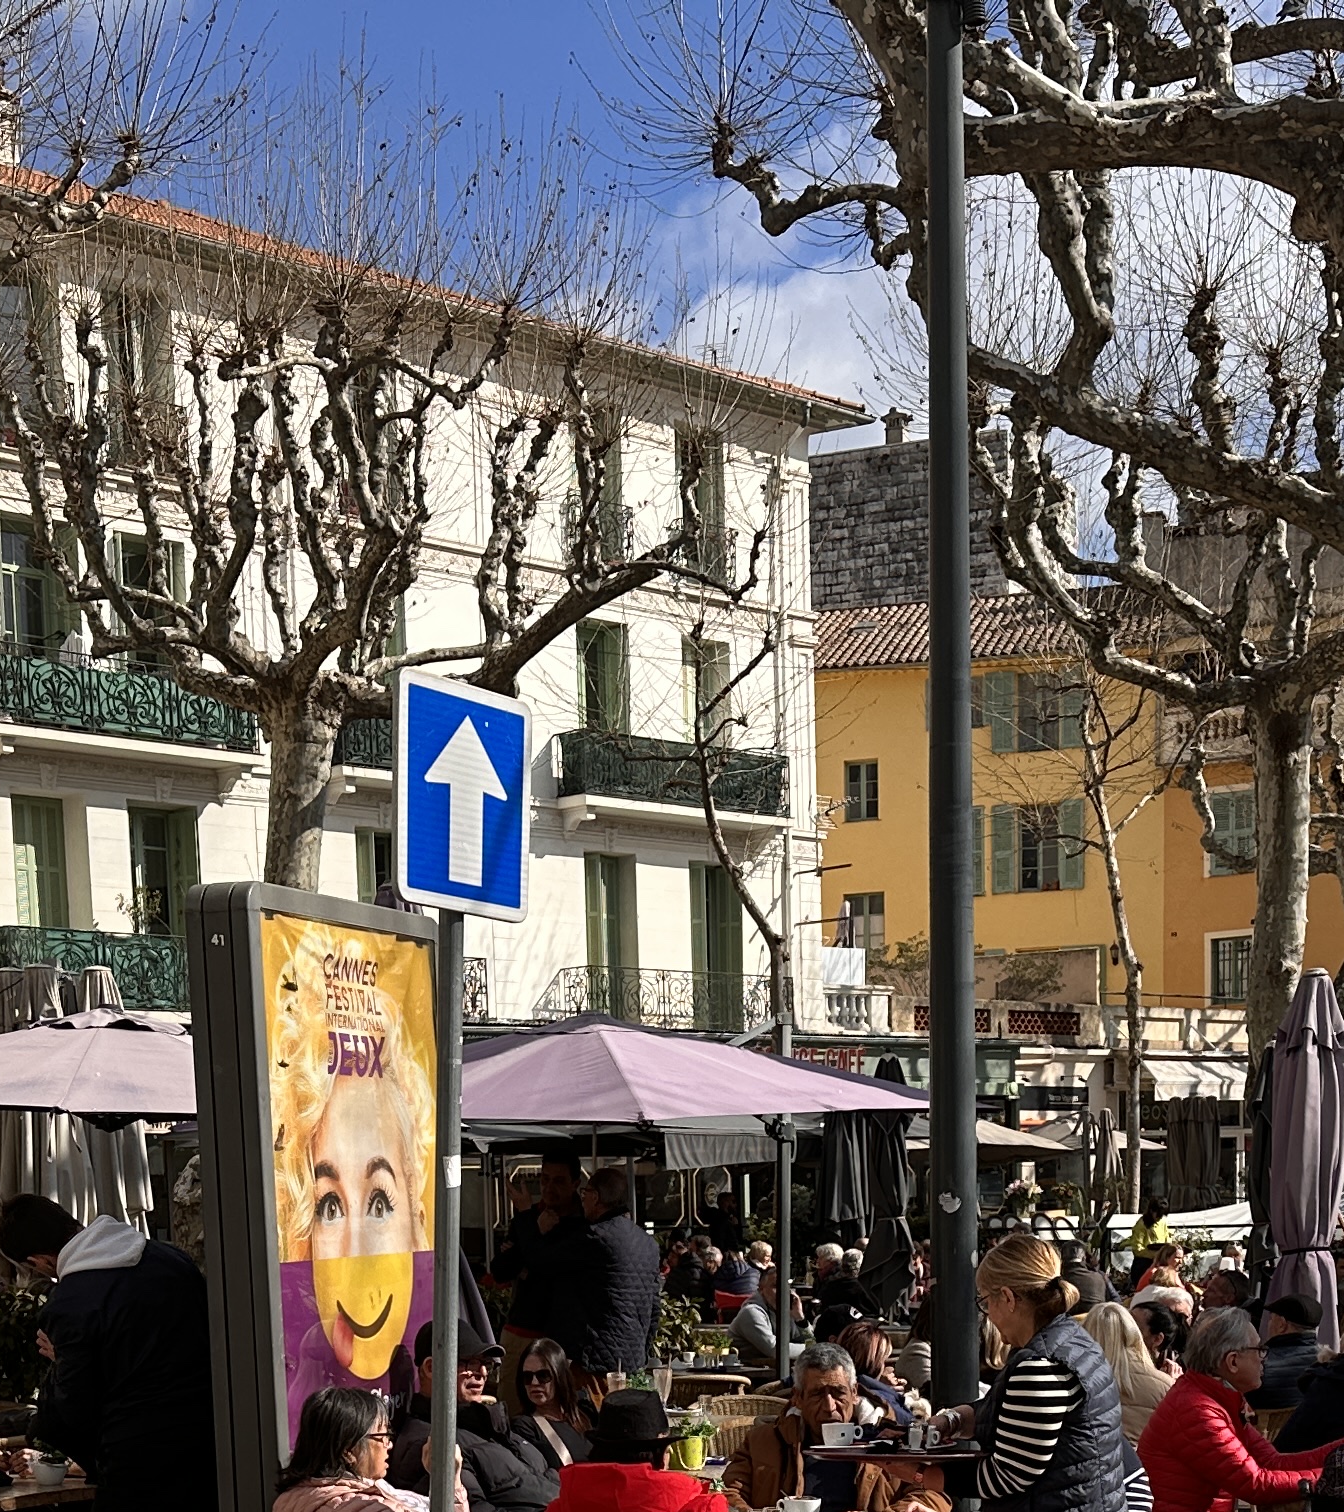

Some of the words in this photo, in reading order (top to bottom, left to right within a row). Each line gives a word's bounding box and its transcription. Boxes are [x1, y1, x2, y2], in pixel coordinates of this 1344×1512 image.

[211, 934, 225, 946] 41
[323, 953, 379, 987] CANNES
[325, 983, 382, 1016] FESTIVAL
[326, 1012, 386, 1033] INTERNATIONAL
[328, 1031, 385, 1078] JEUX
